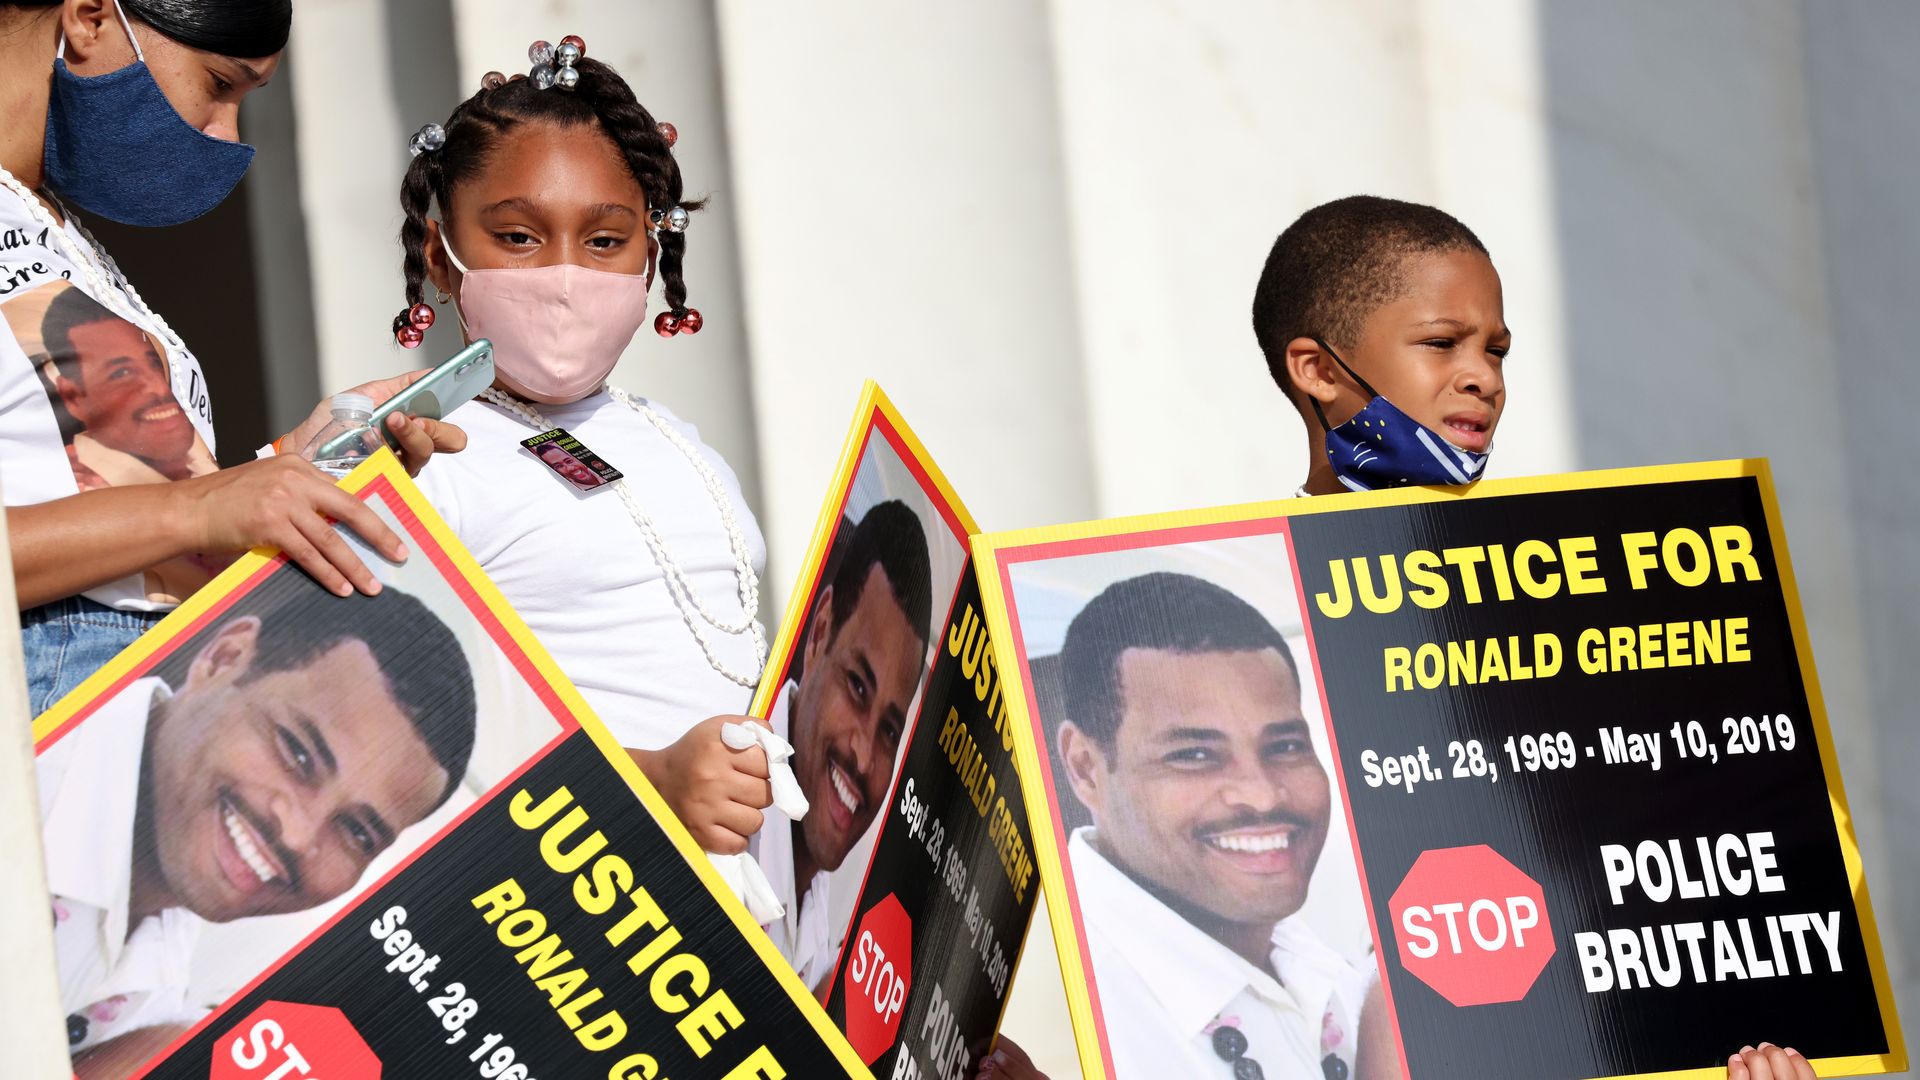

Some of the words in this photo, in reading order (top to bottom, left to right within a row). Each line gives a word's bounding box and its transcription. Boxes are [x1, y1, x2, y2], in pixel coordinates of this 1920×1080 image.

[528, 430, 563, 446] JUSTICE
[1316, 537, 1607, 618] JUSTICE
[1621, 526, 1762, 589] FOR
[1384, 633, 1562, 692] RONALD
[1578, 618, 1750, 674] GREENE
[1361, 746, 1442, 793] Sept.
[1448, 740, 1497, 783] 28,
[1504, 732, 1576, 772] 1969
[1599, 727, 1661, 770] May
[1671, 721, 1717, 764] 10,
[1723, 714, 1795, 754] 2019
[938, 705, 996, 818] RONALD
[988, 796, 1033, 906] GREENE
[900, 777, 929, 843] Sept.
[926, 818, 945, 874] 28,
[943, 843, 967, 902] 1969
[965, 885, 984, 949] May
[980, 918, 994, 972] 10,
[987, 940, 1008, 999] 2019
[1600, 832, 1785, 905] POLICE
[471, 878, 627, 1051] RONALD
[509, 786, 745, 1058] JUSTICE
[1403, 896, 1538, 958] STOP
[1574, 911, 1842, 993] BRUTALITY
[370, 906, 441, 993] Sept.
[427, 983, 478, 1044] 28,
[469, 1033, 537, 1080] 196
[852, 930, 905, 1025] STOP
[232, 1020, 310, 1080] ST
